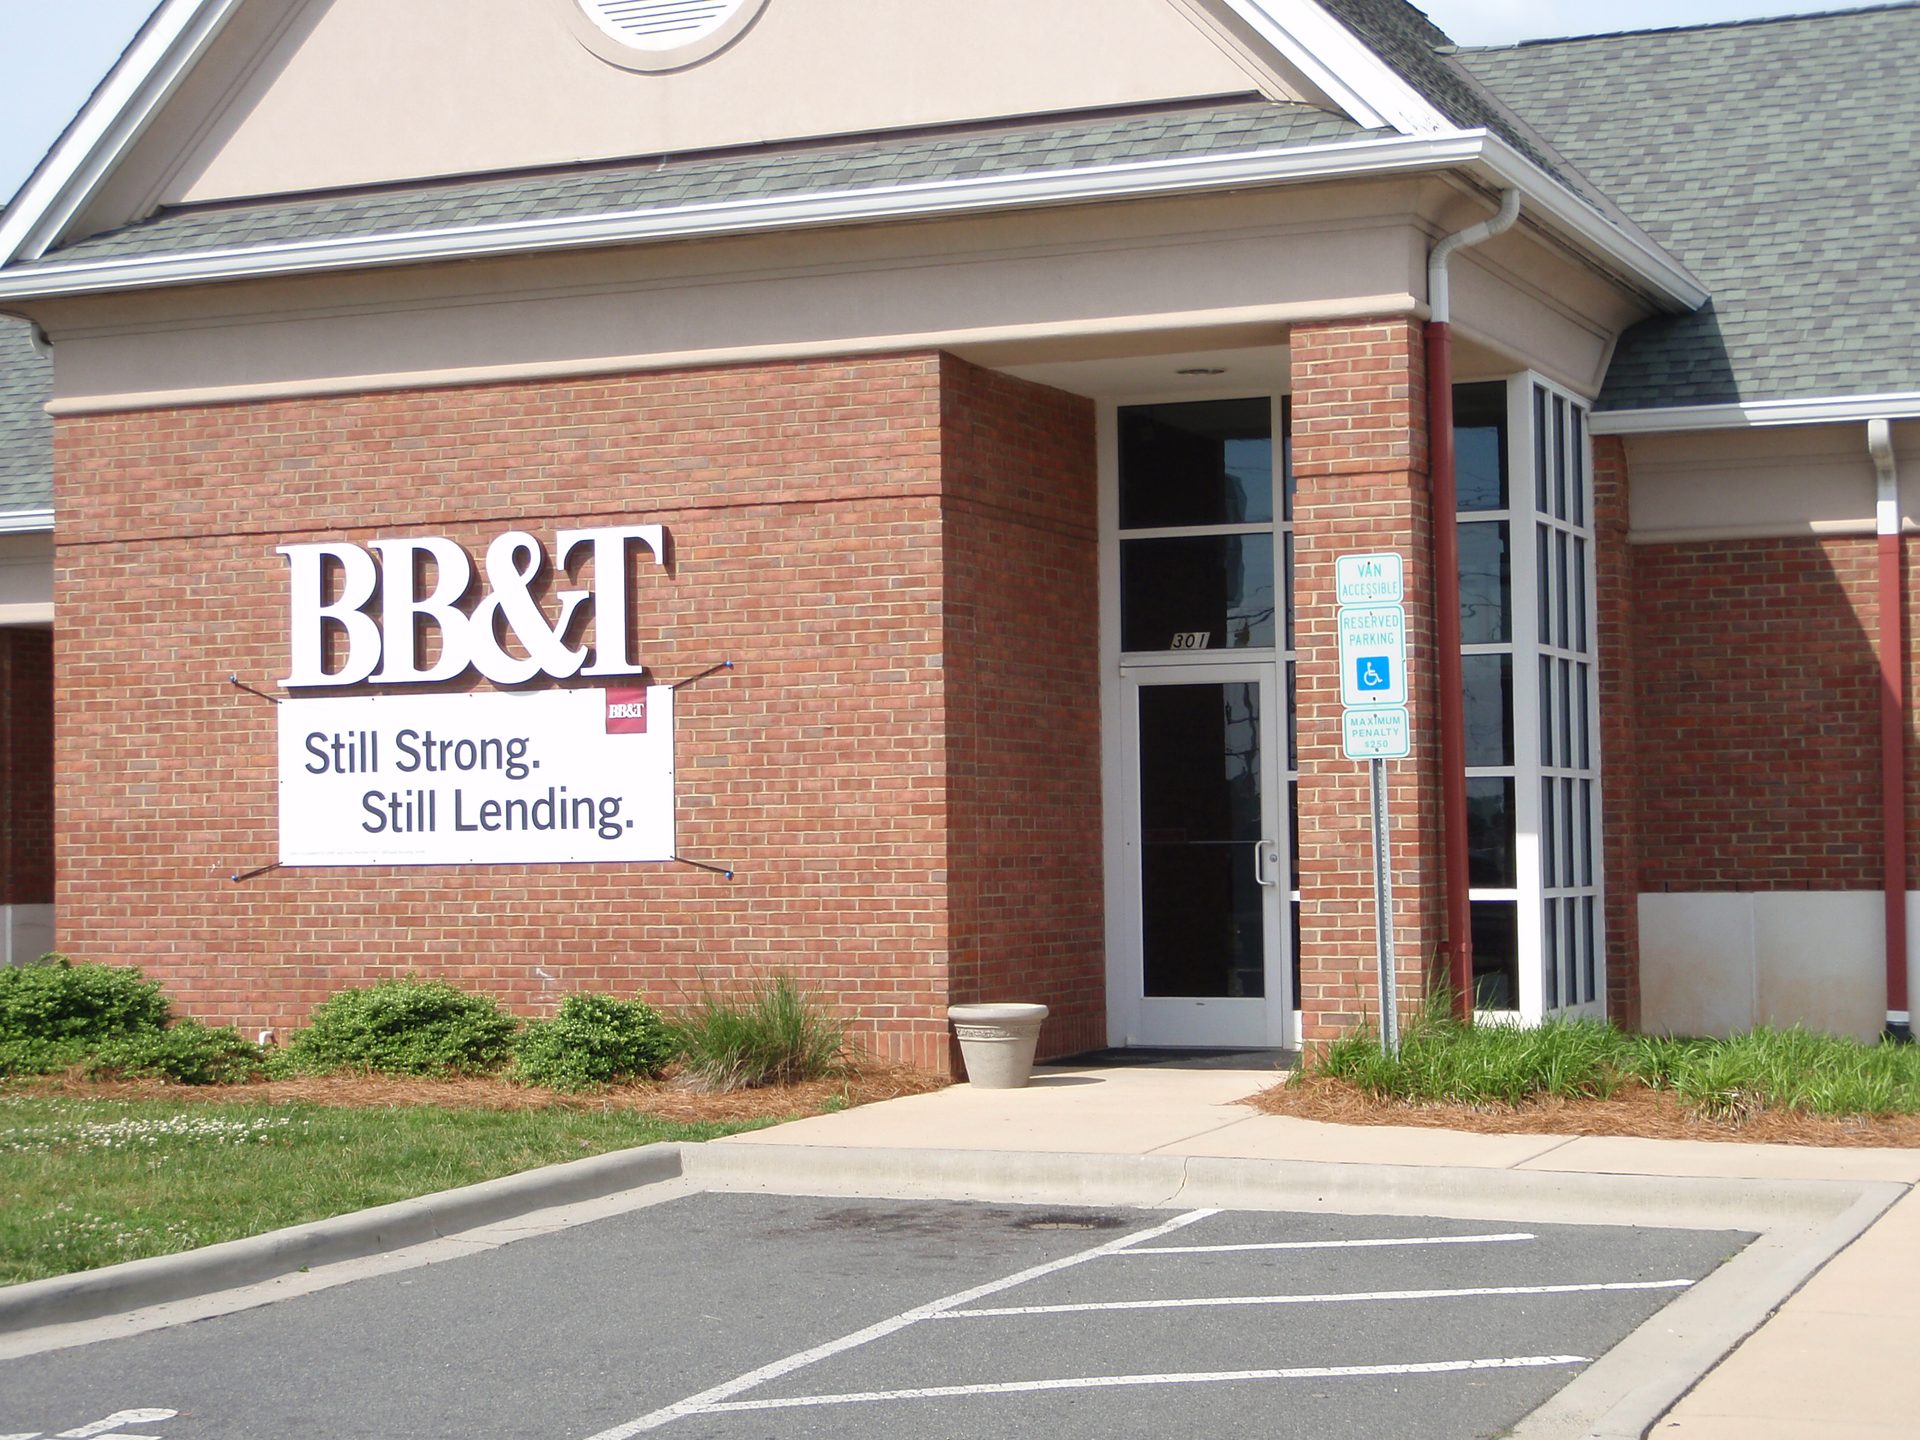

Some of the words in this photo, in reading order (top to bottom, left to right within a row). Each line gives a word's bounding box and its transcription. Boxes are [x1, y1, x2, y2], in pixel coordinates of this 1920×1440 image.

[1357, 563, 1382, 577] VAN
[1342, 581, 1398, 596] ACCESSIBLE
[276, 524, 664, 688] BB&T
[1343, 615, 1399, 630] RESERVED
[1173, 633, 1206, 648] 301
[1349, 632, 1394, 646] PARKING
[608, 703, 644, 719] BB&T
[1350, 716, 1400, 727] MAXIMUM
[1352, 728, 1399, 737] PENALTY
[1364, 740, 1388, 748] $250
[305, 730, 379, 774] Still
[395, 729, 540, 780] Strong.
[361, 789, 436, 833] Still
[454, 786, 634, 840] Lending.
